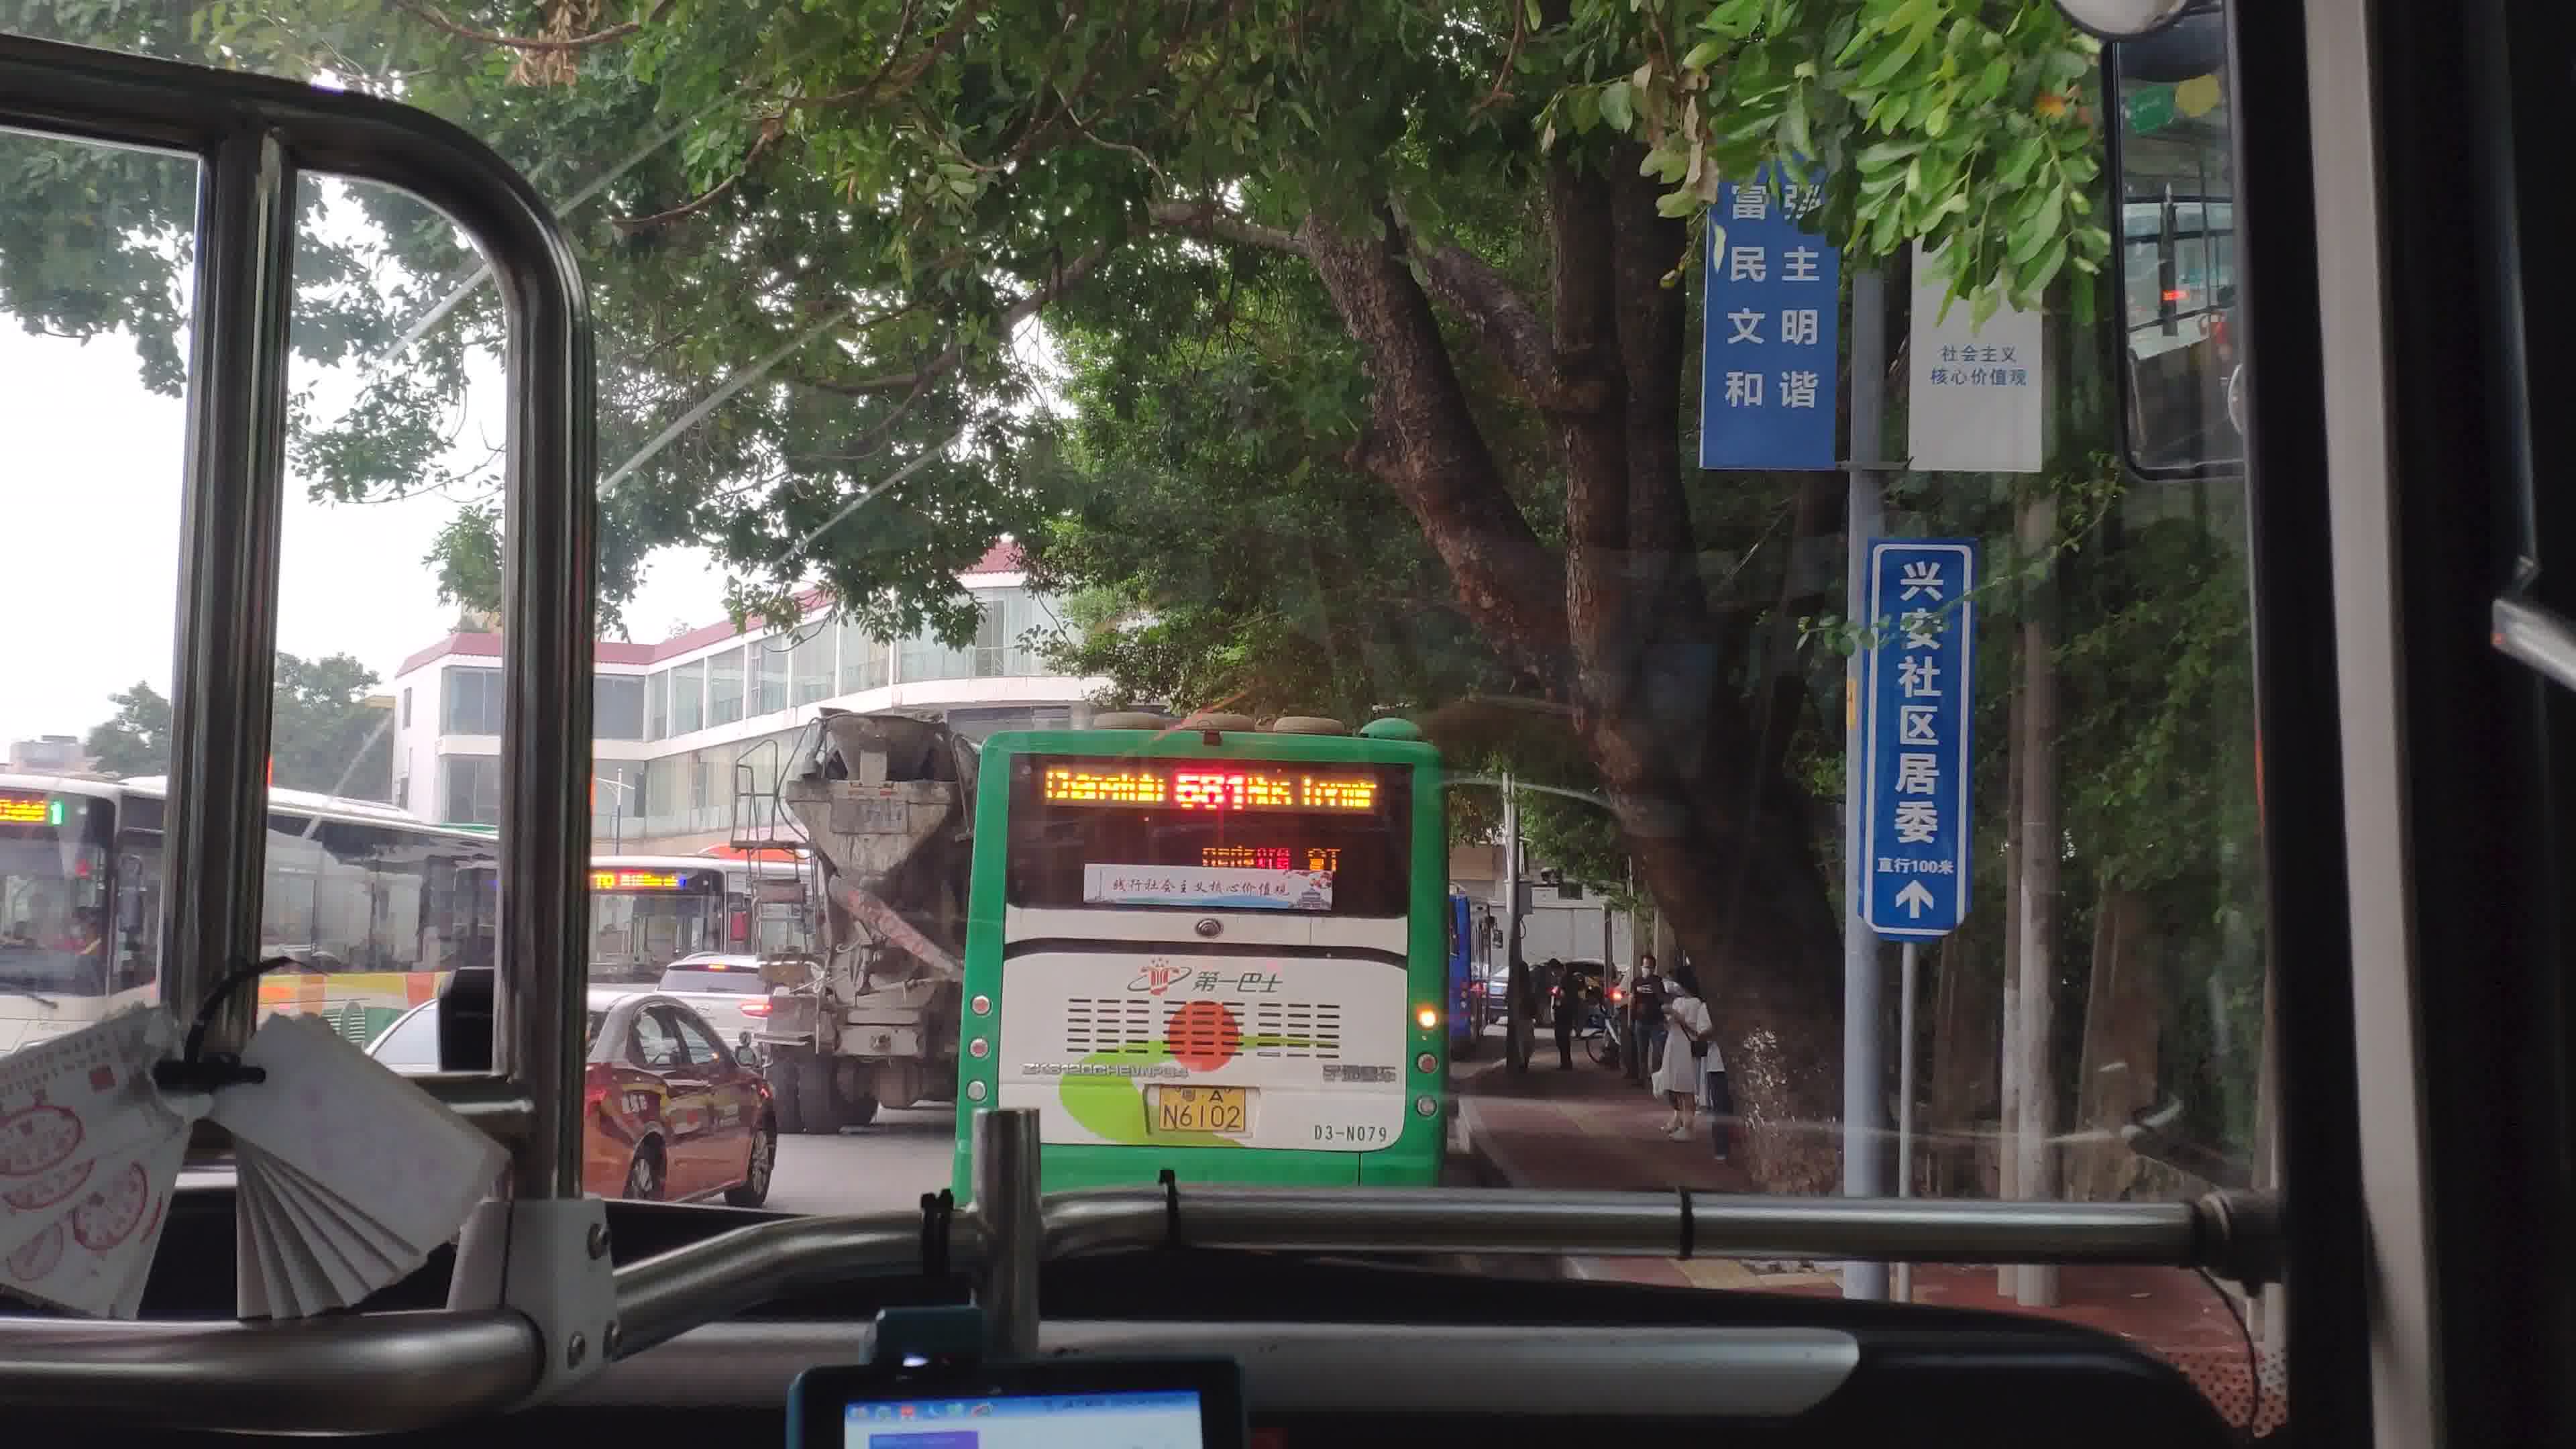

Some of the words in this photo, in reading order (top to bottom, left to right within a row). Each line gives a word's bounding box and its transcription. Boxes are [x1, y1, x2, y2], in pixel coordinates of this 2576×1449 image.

[1730, 246, 1820, 282] 民主
[1727, 307, 1818, 345] 文明
[1938, 343, 2018, 363] 社会主义
[1929, 367, 2028, 387] 核心价值观
[1725, 371, 1819, 409] 和谐
[1894, 560, 1944, 844] 兴安社区居委
[1877, 857, 1954, 875] 直行100米
[1192, 971, 1283, 993] 第一巴士
[1163, 1105, 1241, 1128] N6102
[1313, 1124, 1388, 1142] D3-N079
